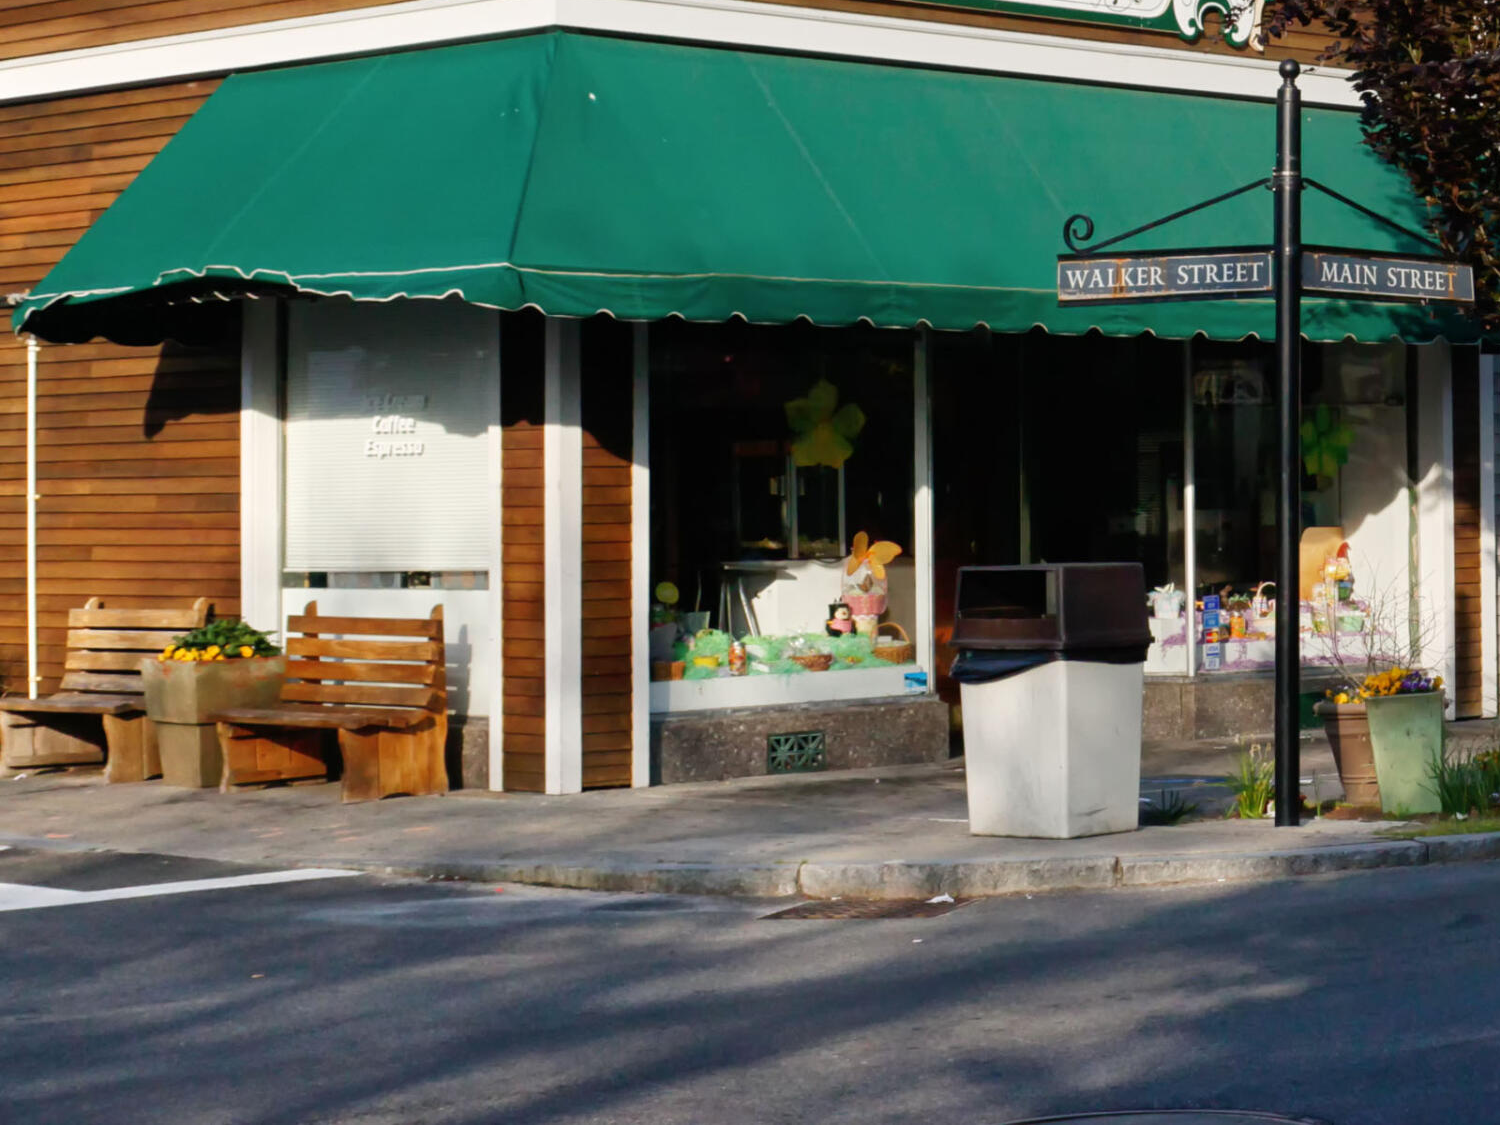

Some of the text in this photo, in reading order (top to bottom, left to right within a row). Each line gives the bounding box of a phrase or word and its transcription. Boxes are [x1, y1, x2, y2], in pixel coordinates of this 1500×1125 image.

[1066, 261, 1265, 289] WALKER STREET
[1321, 261, 1457, 292] MAIN STREET
[373, 415, 417, 435] Coffee
[365, 440, 425, 460] Espresso
